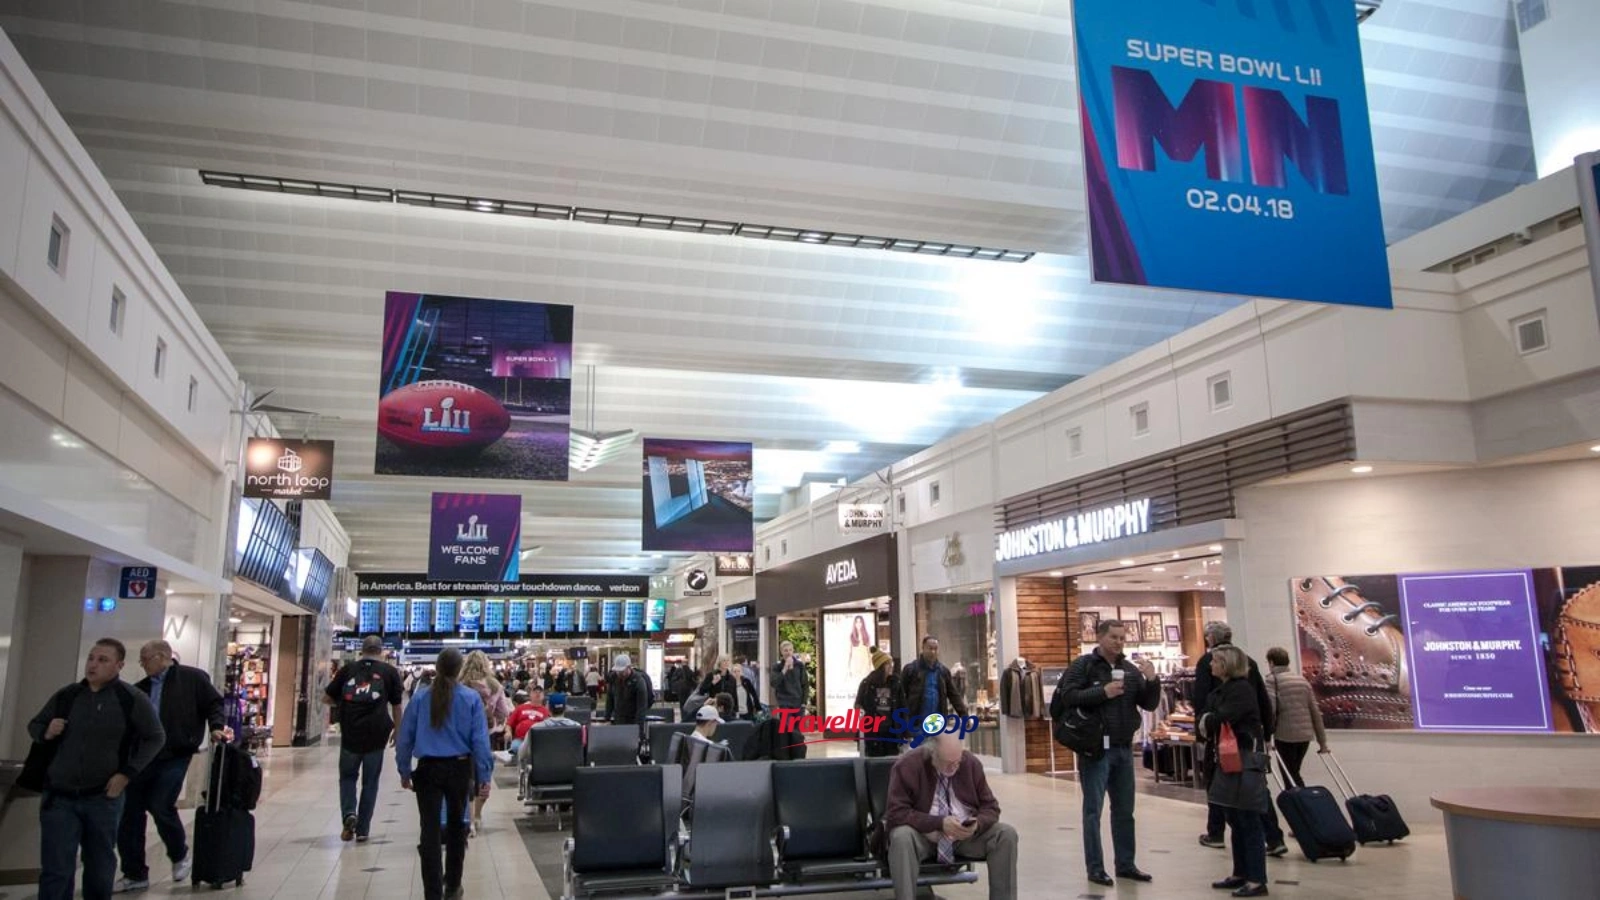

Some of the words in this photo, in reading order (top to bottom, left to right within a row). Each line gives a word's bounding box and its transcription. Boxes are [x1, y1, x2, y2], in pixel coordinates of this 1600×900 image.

[1126, 38, 1214, 70] SUPER
[1219, 53, 1291, 82] BOWL
[1295, 65, 1322, 86] LII
[1111, 64, 1349, 196] MN
[1186, 188, 1294, 220] 02.04.18
[422, 397, 471, 428] LII
[247, 473, 292, 486] north
[295, 473, 329, 490] loop
[273, 486, 302, 496] market
[843, 508, 884, 518] JOHNSON
[456, 514, 488, 541] LII
[844, 519, 850, 528] &
[851, 519, 883, 529] MURPHY
[995, 519, 1065, 562] JOHNSTON
[1065, 515, 1078, 548] &
[1077, 498, 1150, 545] MURPHY
[441, 545, 500, 555] WELCOME
[454, 555, 487, 565] FANS
[129, 568, 150, 577] AED
[825, 558, 858, 585] AVEDA
[360, 581, 369, 590] in
[370, 581, 413, 591] America.
[415, 582, 437, 591] Best
[438, 582, 451, 591] for
[453, 582, 499, 592] streaming
[500, 584, 521, 593] your
[522, 583, 572, 592] touchdown
[573, 583, 603, 592] dance.
[609, 584, 640, 592] verizon
[1423, 641, 1472, 652] JOHNSTON
[1472, 640, 1481, 651] &
